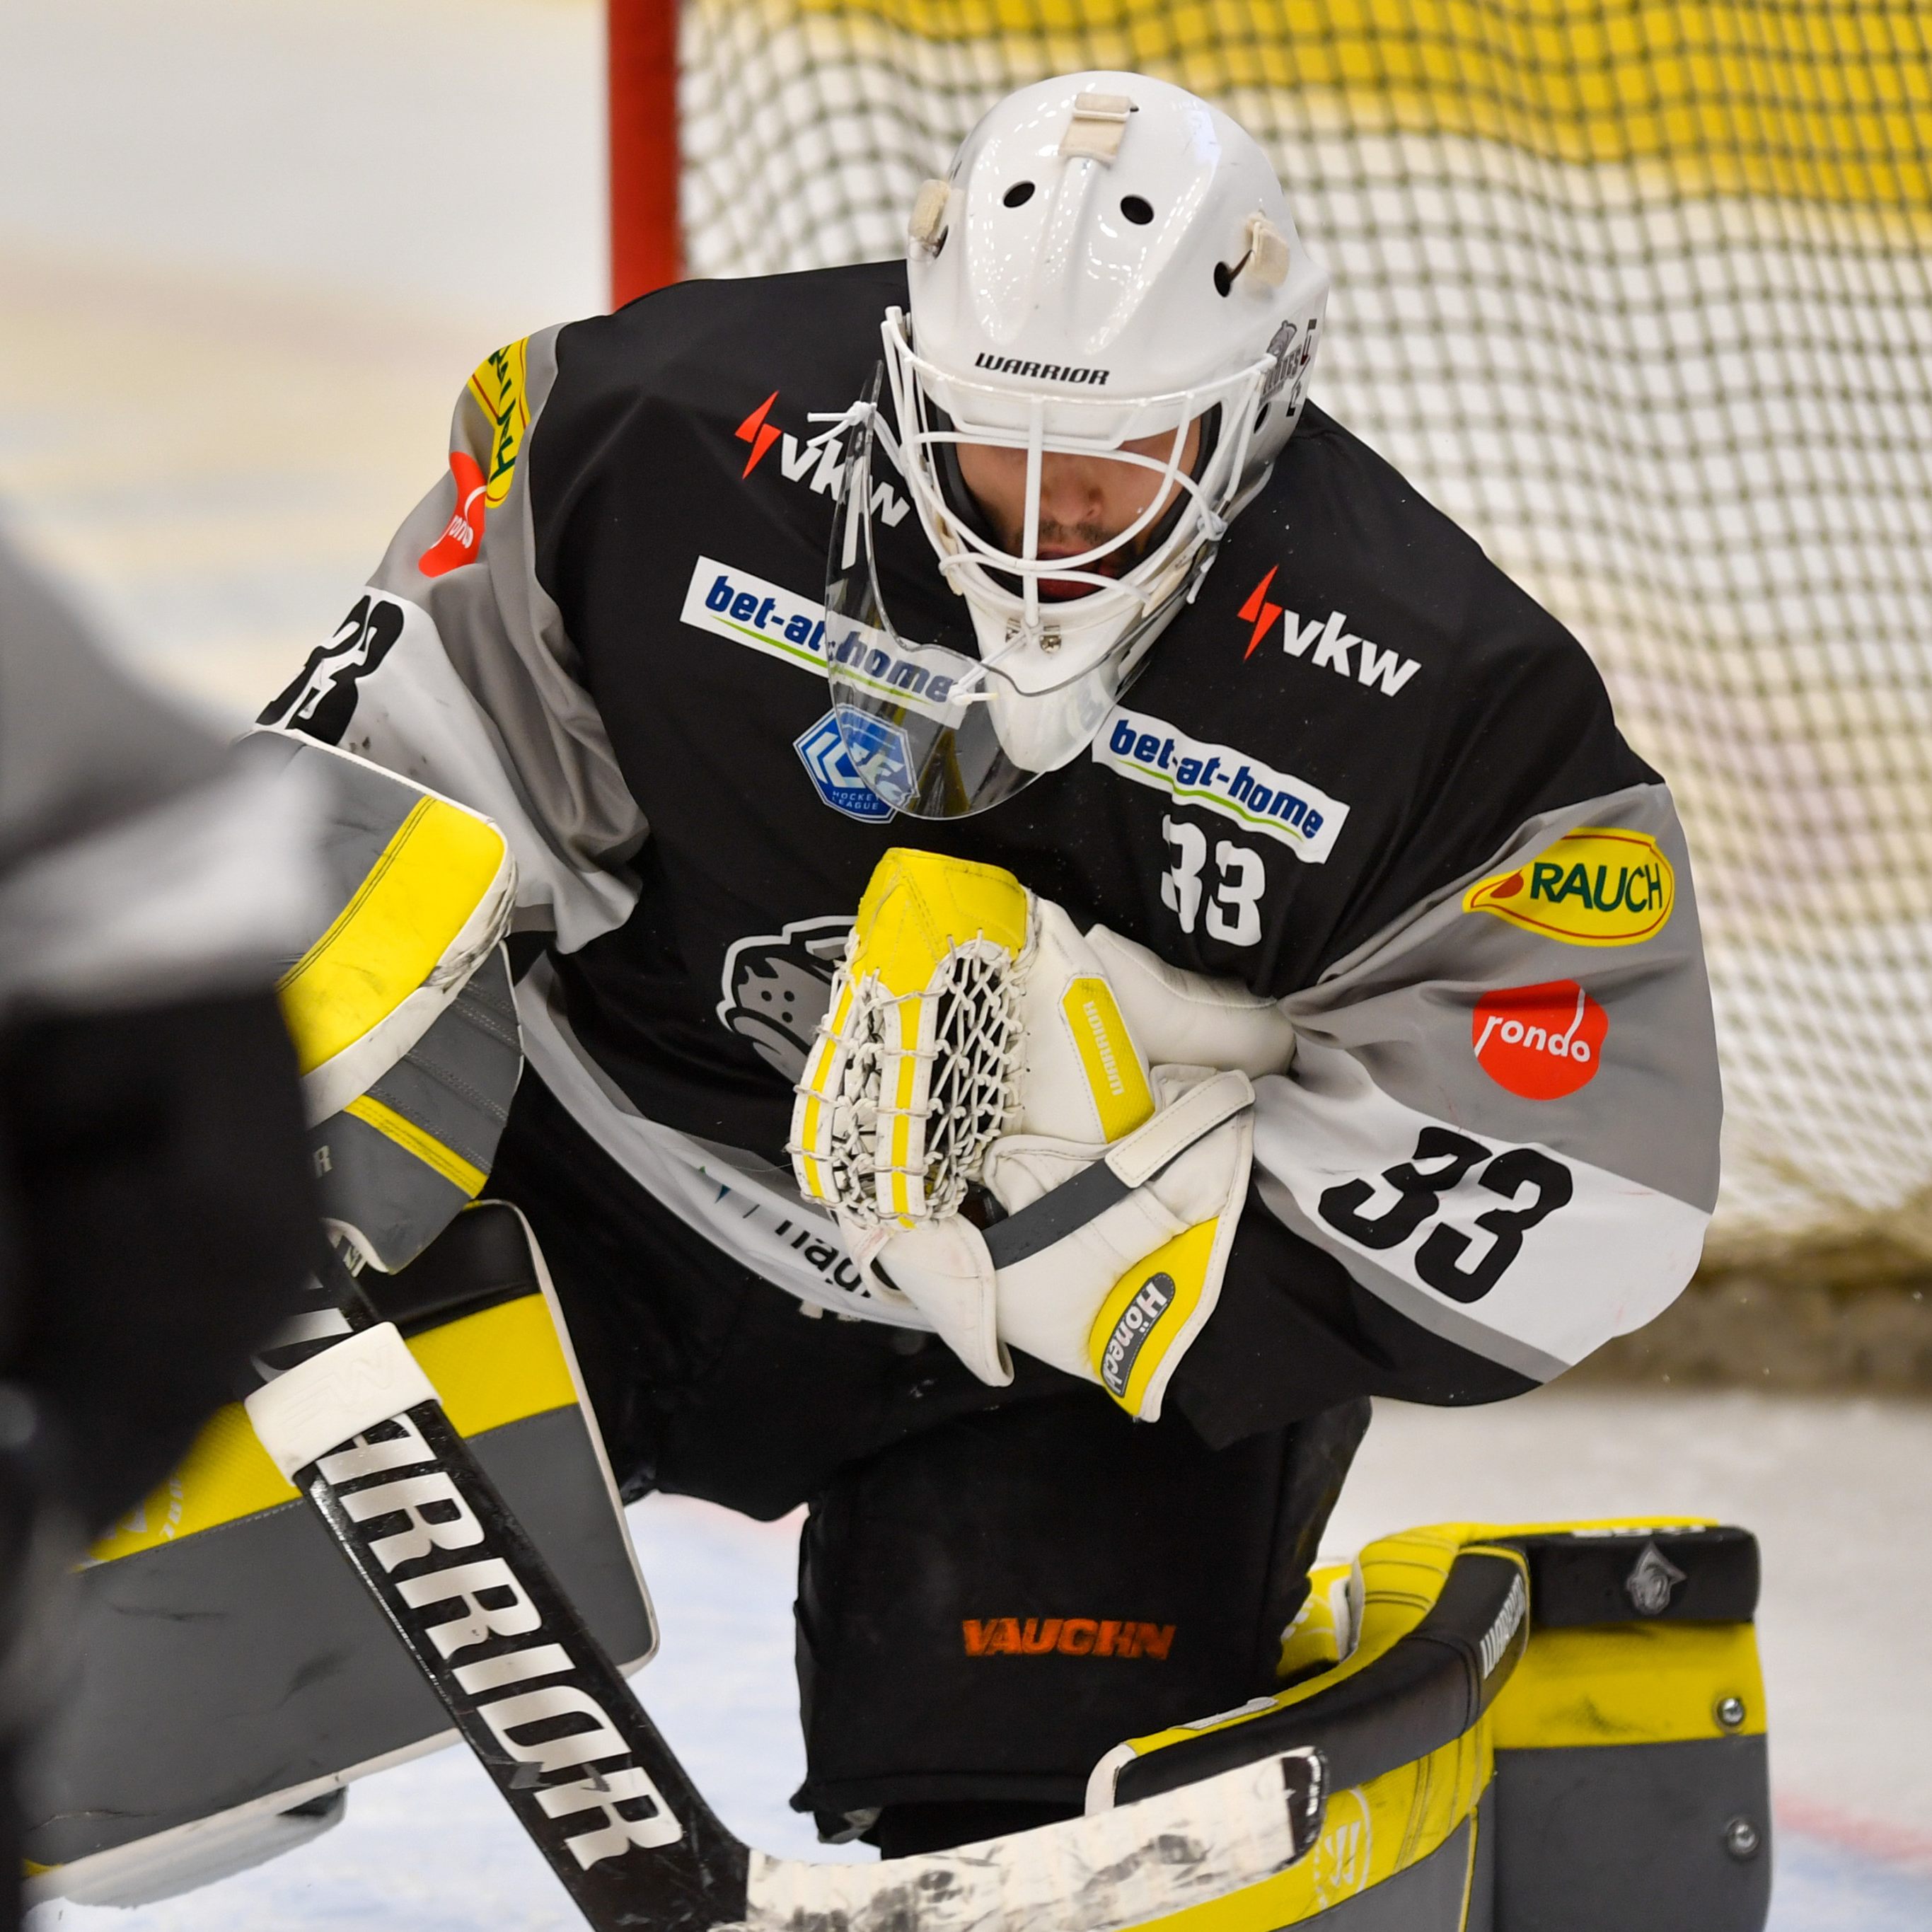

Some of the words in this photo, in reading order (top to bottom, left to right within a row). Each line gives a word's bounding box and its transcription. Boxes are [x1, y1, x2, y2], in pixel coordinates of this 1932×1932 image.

[974, 352, 1110, 386] WARRIOR
[1283, 609, 1421, 698] vkw
[1109, 719, 1324, 839] bet-at-home
[1161, 814, 1266, 947] 33
[1529, 862, 1663, 913] RAUCH
[1473, 988, 1591, 1063] rondo
[1318, 1126, 1573, 1304] 33
[962, 1617, 1176, 1660] VAUGHN
